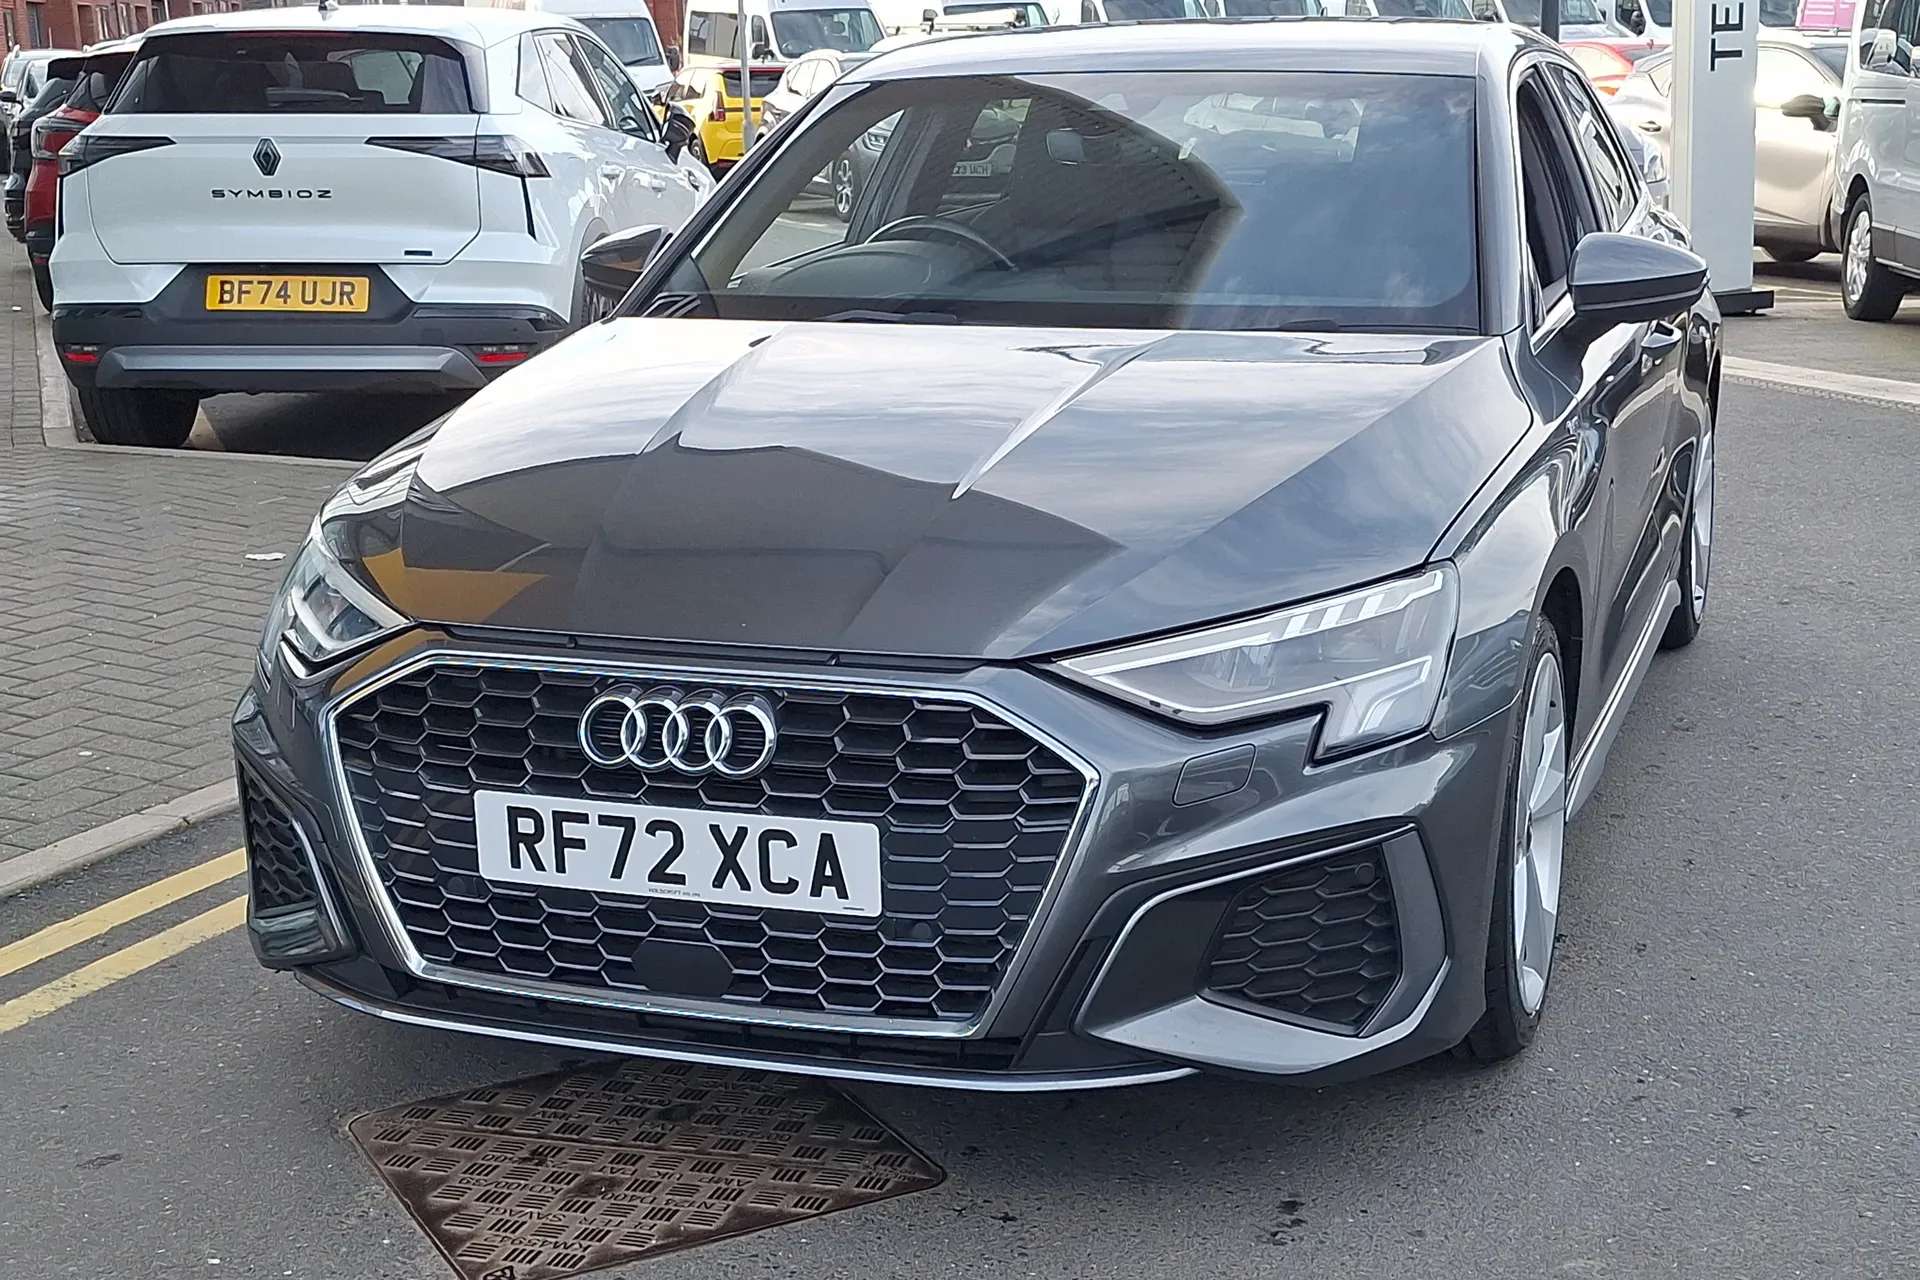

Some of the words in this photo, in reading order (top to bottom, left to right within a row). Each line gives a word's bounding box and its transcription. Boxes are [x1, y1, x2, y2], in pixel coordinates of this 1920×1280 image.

[211, 189, 333, 199] SYMBIOZ
[218, 280, 291, 305] BF74
[301, 280, 356, 306] UJR
[506, 805, 687, 886] RF72
[708, 823, 850, 901] XCA
